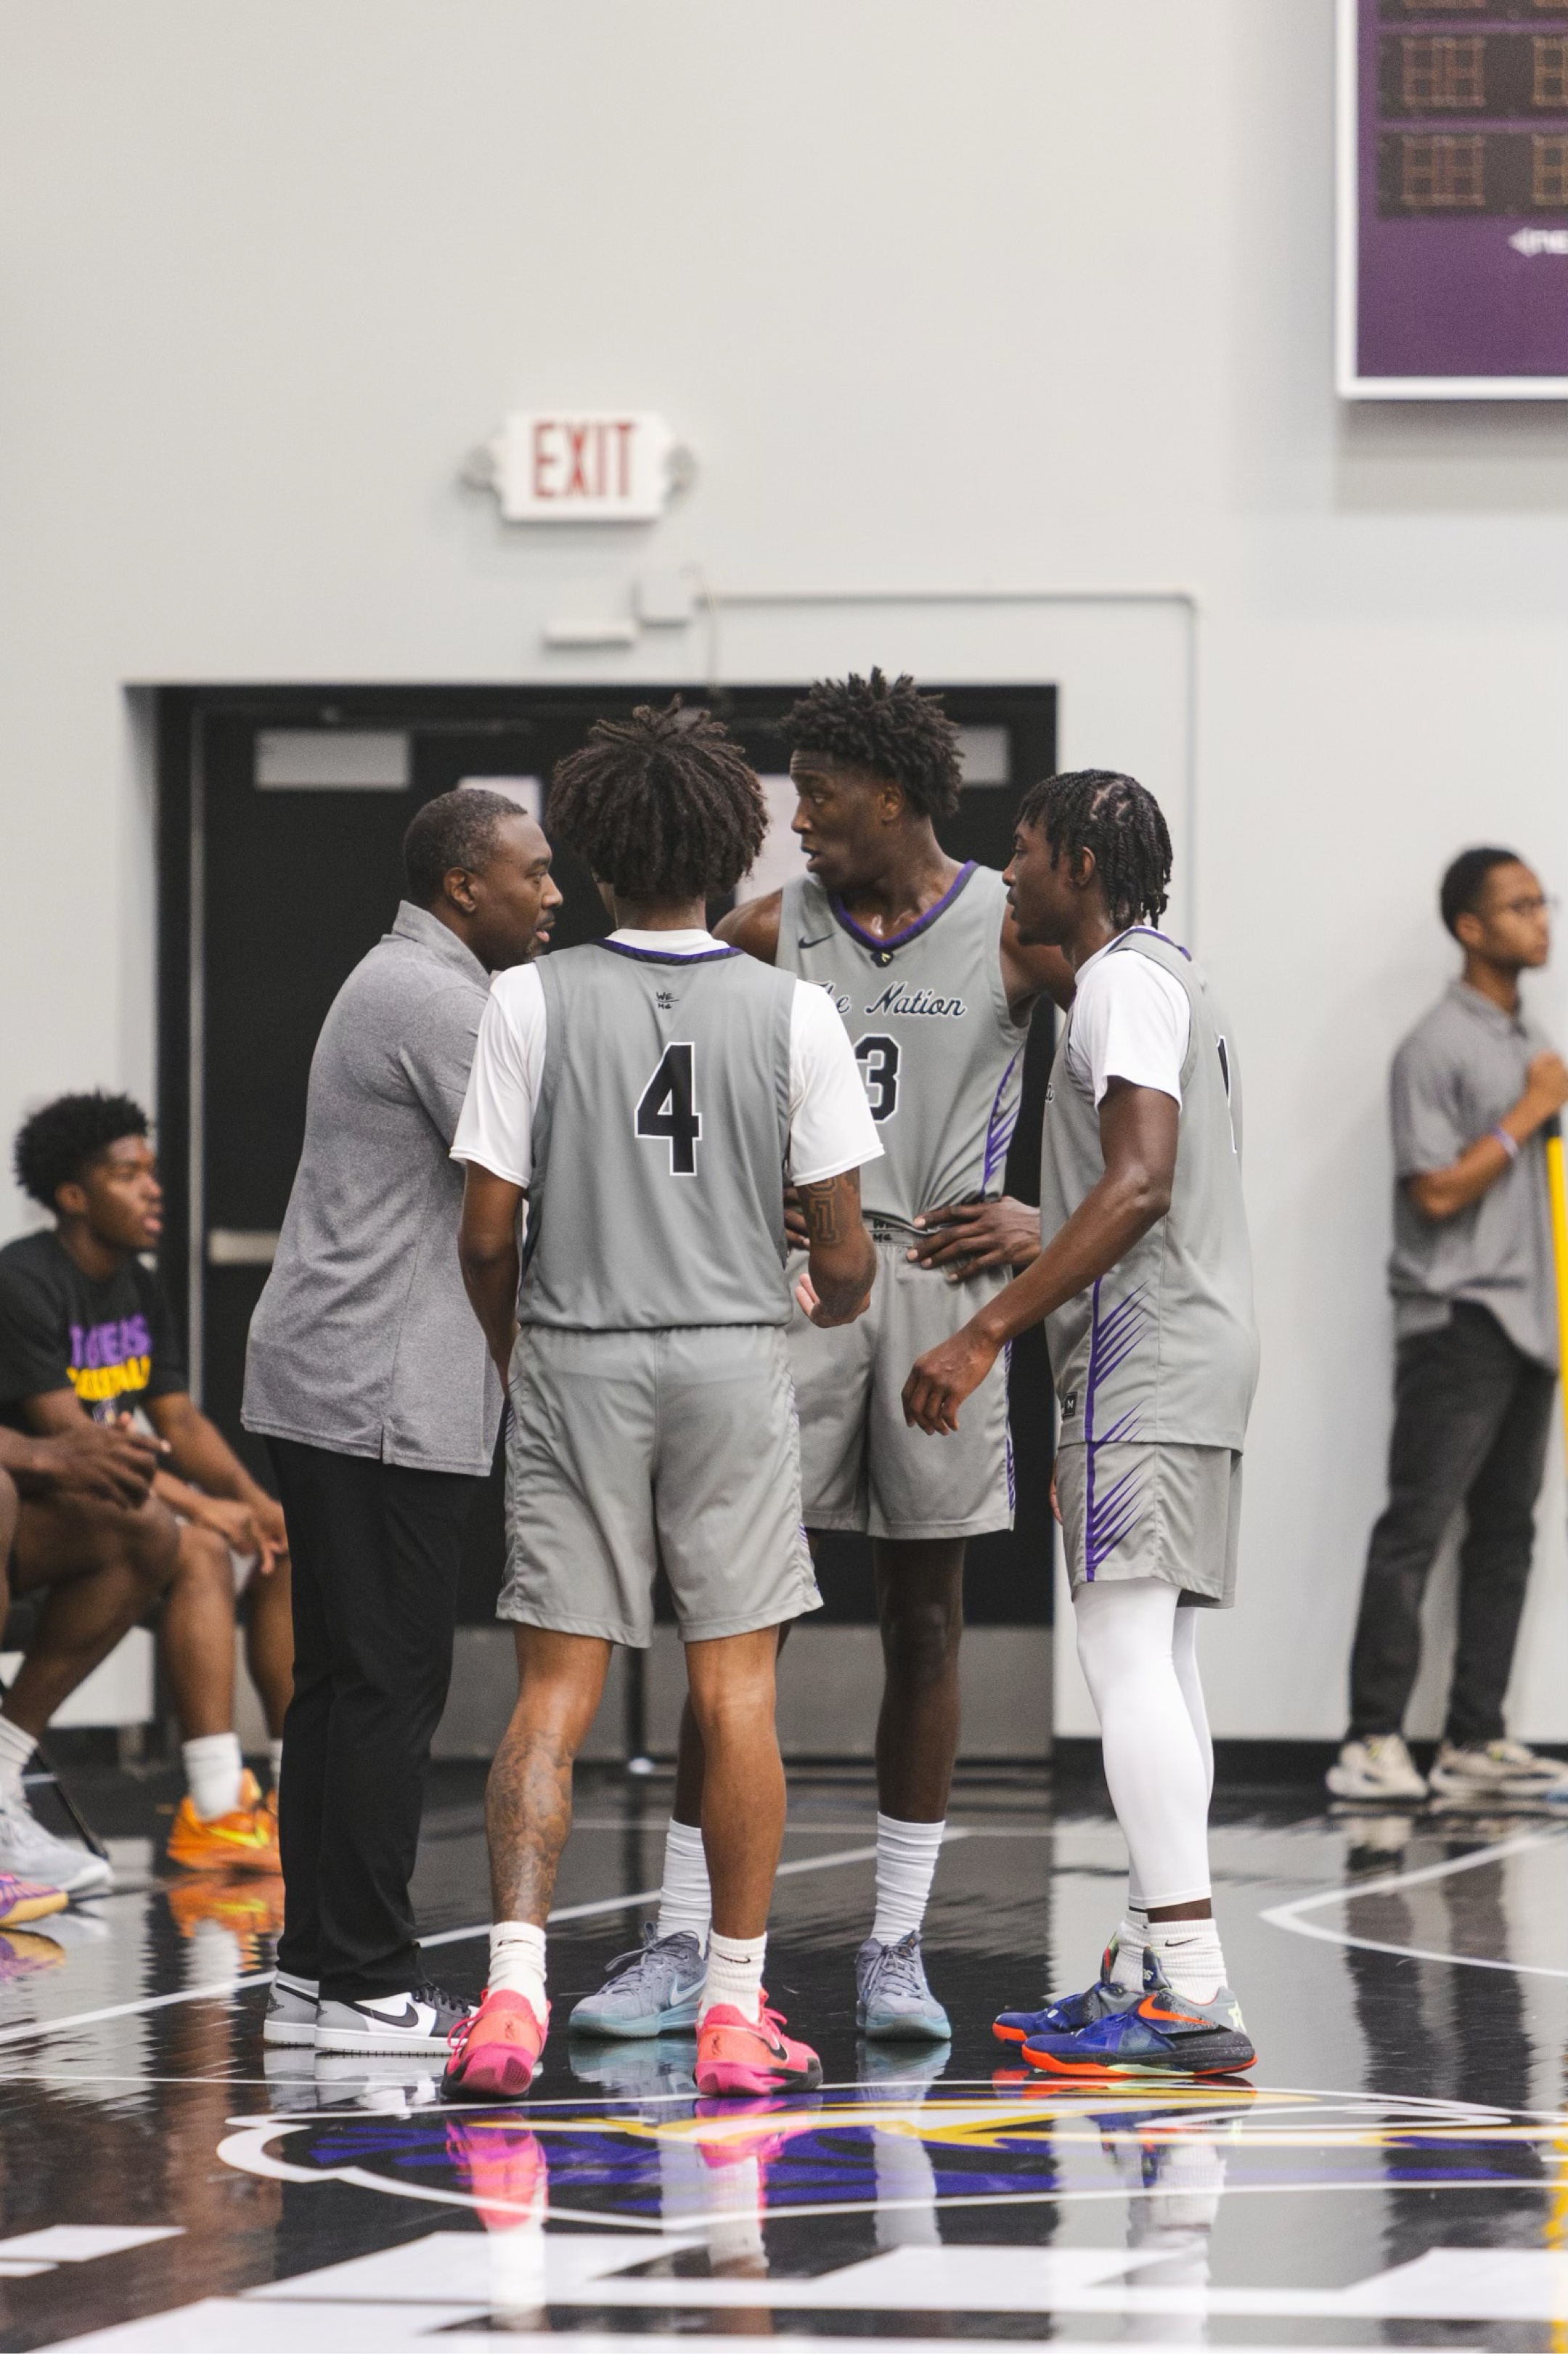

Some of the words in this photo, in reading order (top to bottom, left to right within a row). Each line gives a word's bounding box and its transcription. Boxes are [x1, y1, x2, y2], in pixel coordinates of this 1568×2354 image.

[531, 419, 637, 500] EXIT
[864, 981, 967, 1017] Nation
[634, 1041, 702, 1176] 4
[854, 1033, 901, 1123] 3
